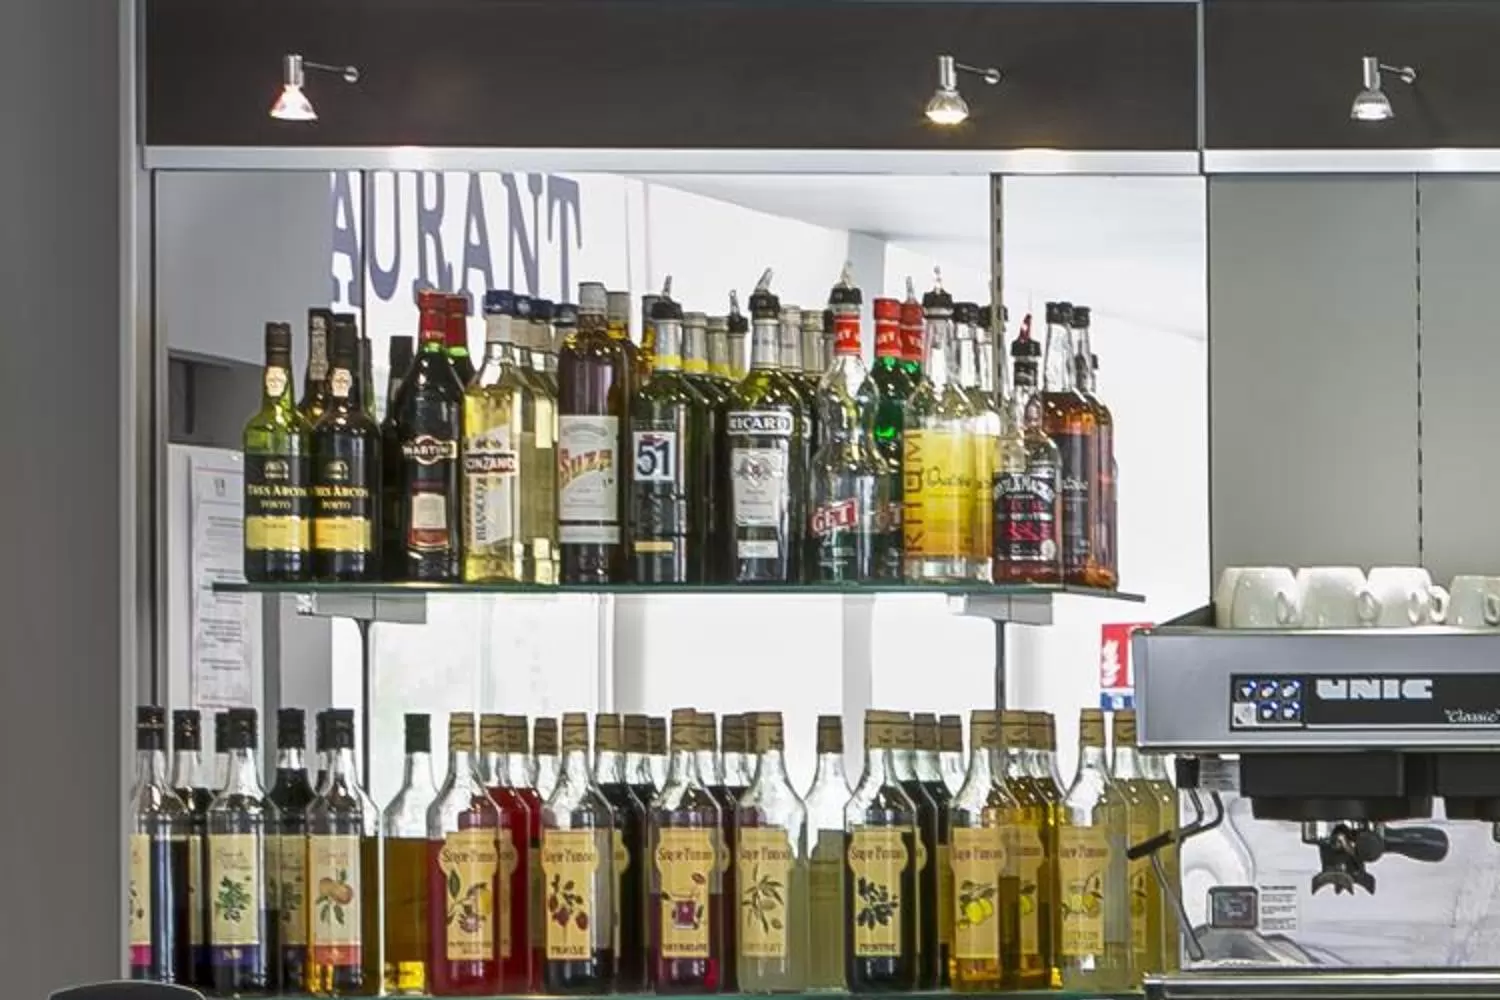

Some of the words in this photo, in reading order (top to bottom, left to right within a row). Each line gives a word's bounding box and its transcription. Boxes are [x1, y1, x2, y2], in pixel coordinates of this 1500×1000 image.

[330, 171, 582, 317] AURANT
[728, 416, 789, 431] RICARD
[464, 457, 515, 470] CINZANO
[637, 440, 670, 476] 51
[904, 433, 924, 552] RHUM
[811, 503, 853, 534] GET
[1316, 679, 1433, 700] UNIC
